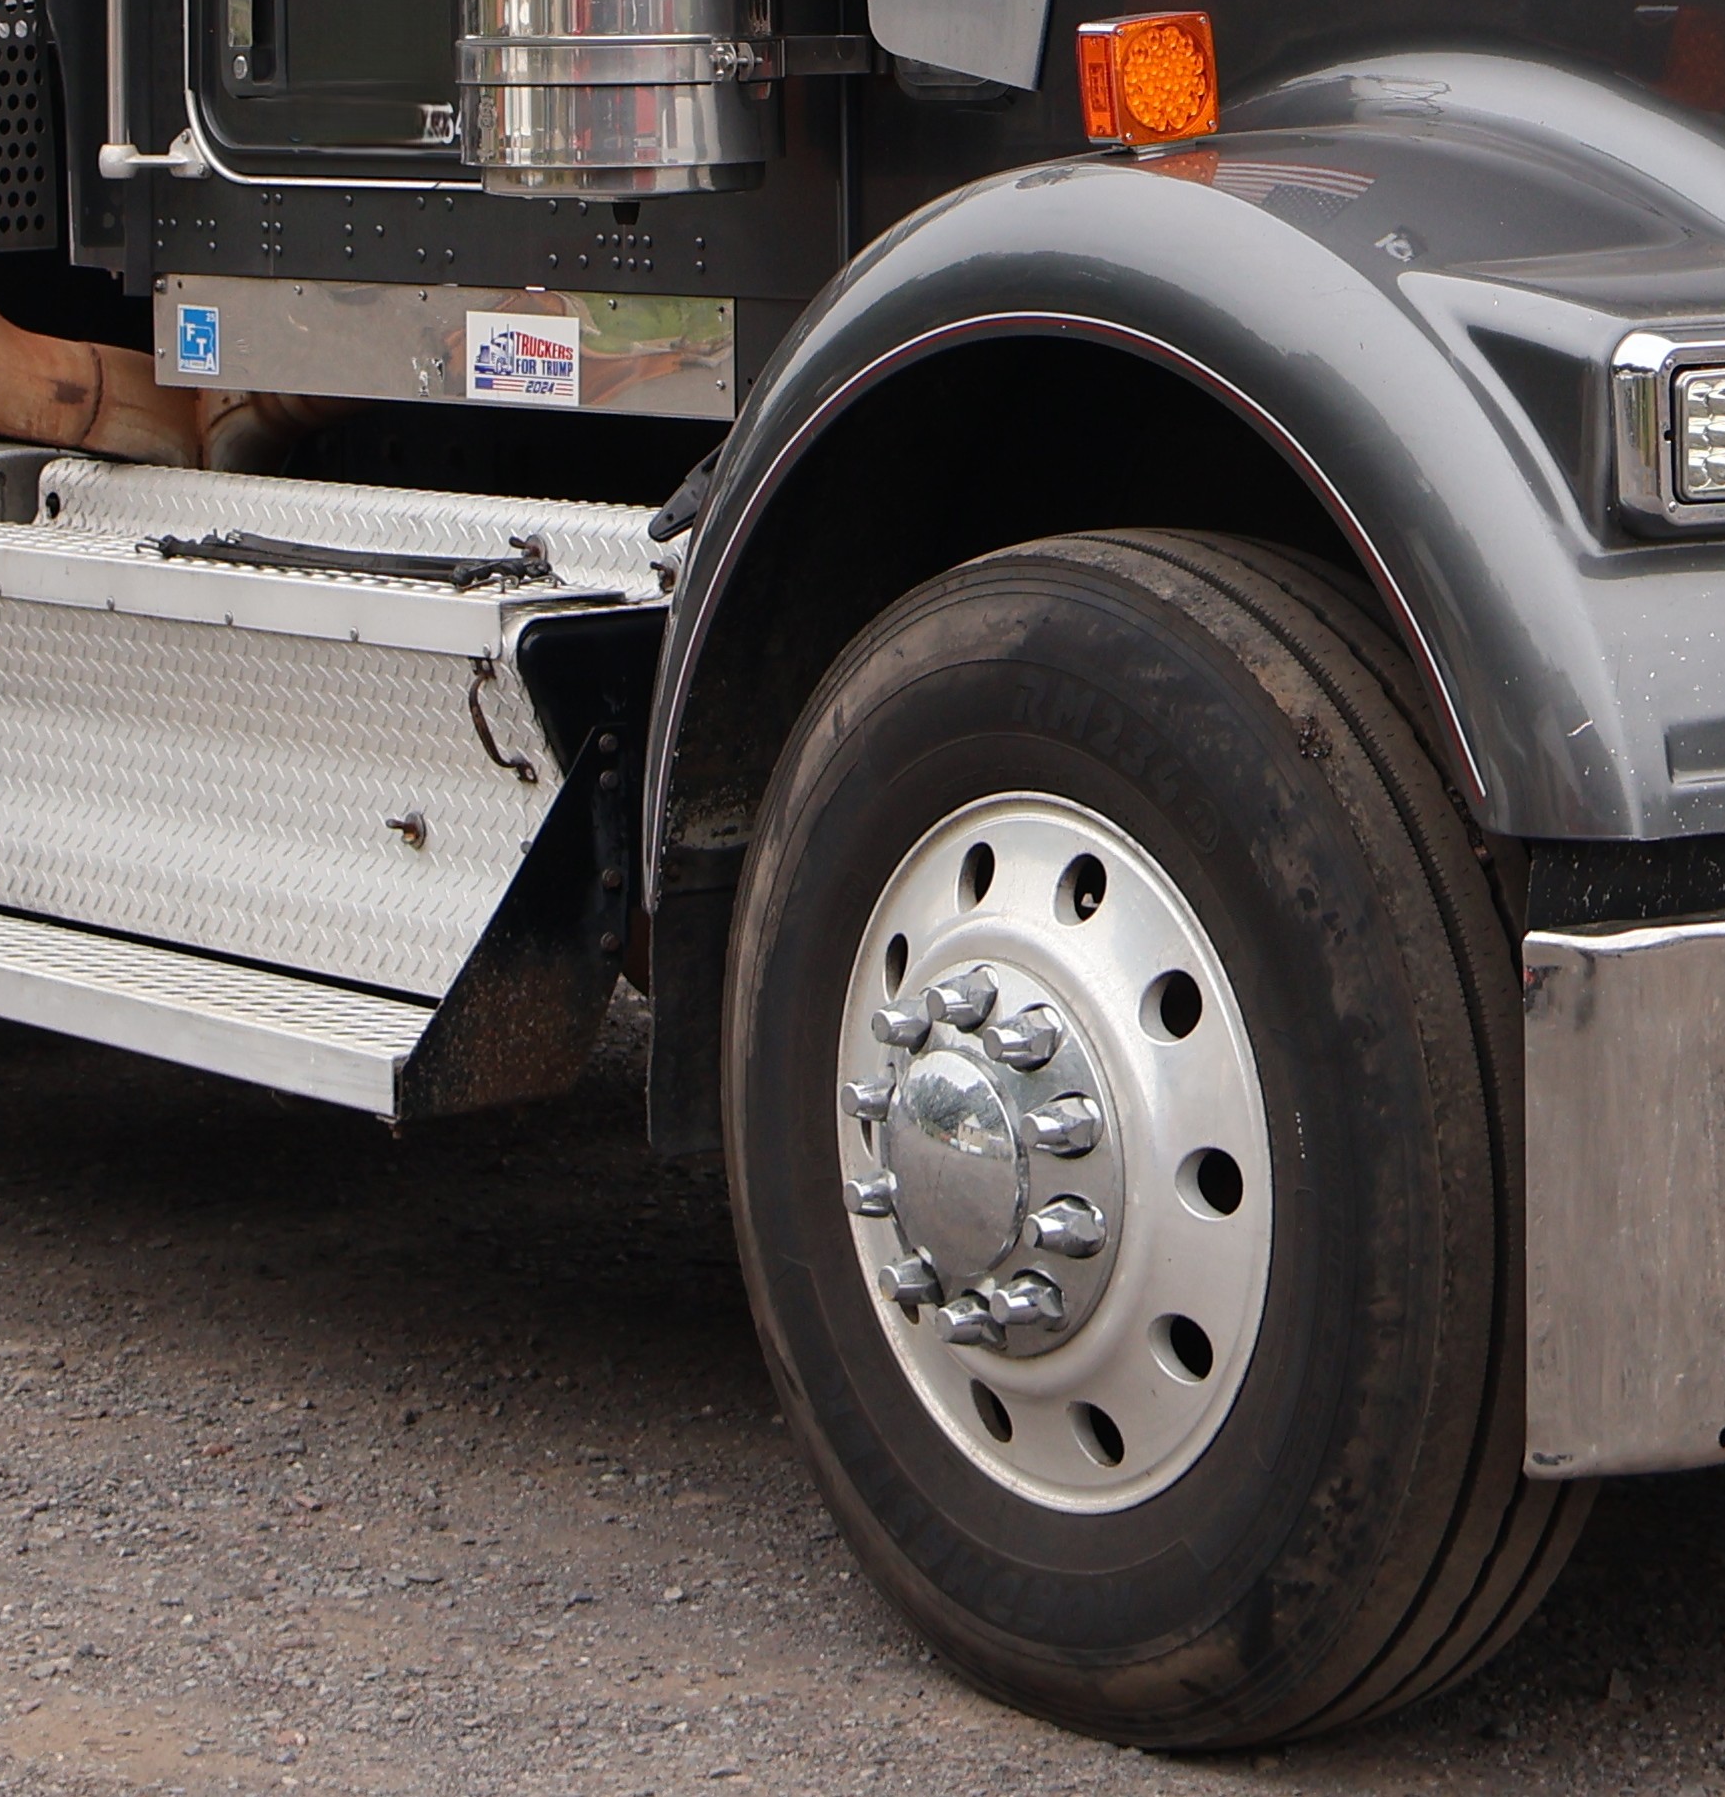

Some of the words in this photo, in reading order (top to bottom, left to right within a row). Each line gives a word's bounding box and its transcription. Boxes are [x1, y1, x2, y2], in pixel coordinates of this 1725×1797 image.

[516, 331, 574, 361] TRUCKERS
[516, 358, 537, 375] FOR
[541, 359, 574, 378] TRUMP
[525, 380, 555, 395] 2024
